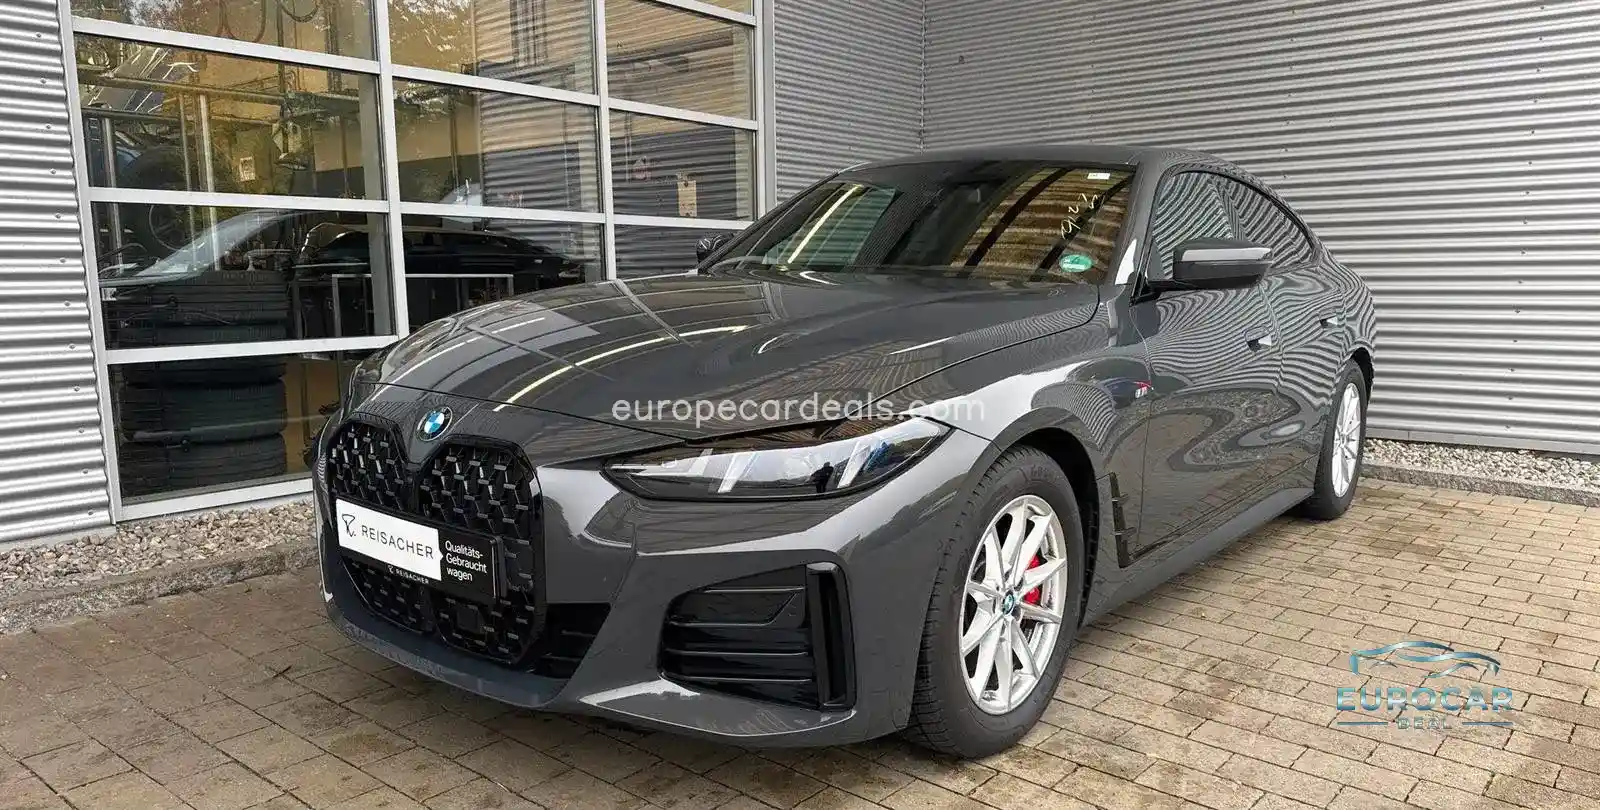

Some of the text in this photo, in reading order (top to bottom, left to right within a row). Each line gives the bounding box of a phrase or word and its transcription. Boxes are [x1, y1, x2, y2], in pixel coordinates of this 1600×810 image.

[361, 524, 434, 560] REISACHER
[445, 540, 484, 559] Qualitäts-
[446, 552, 488, 574] Gebraucht
[446, 567, 473, 582] wagen
